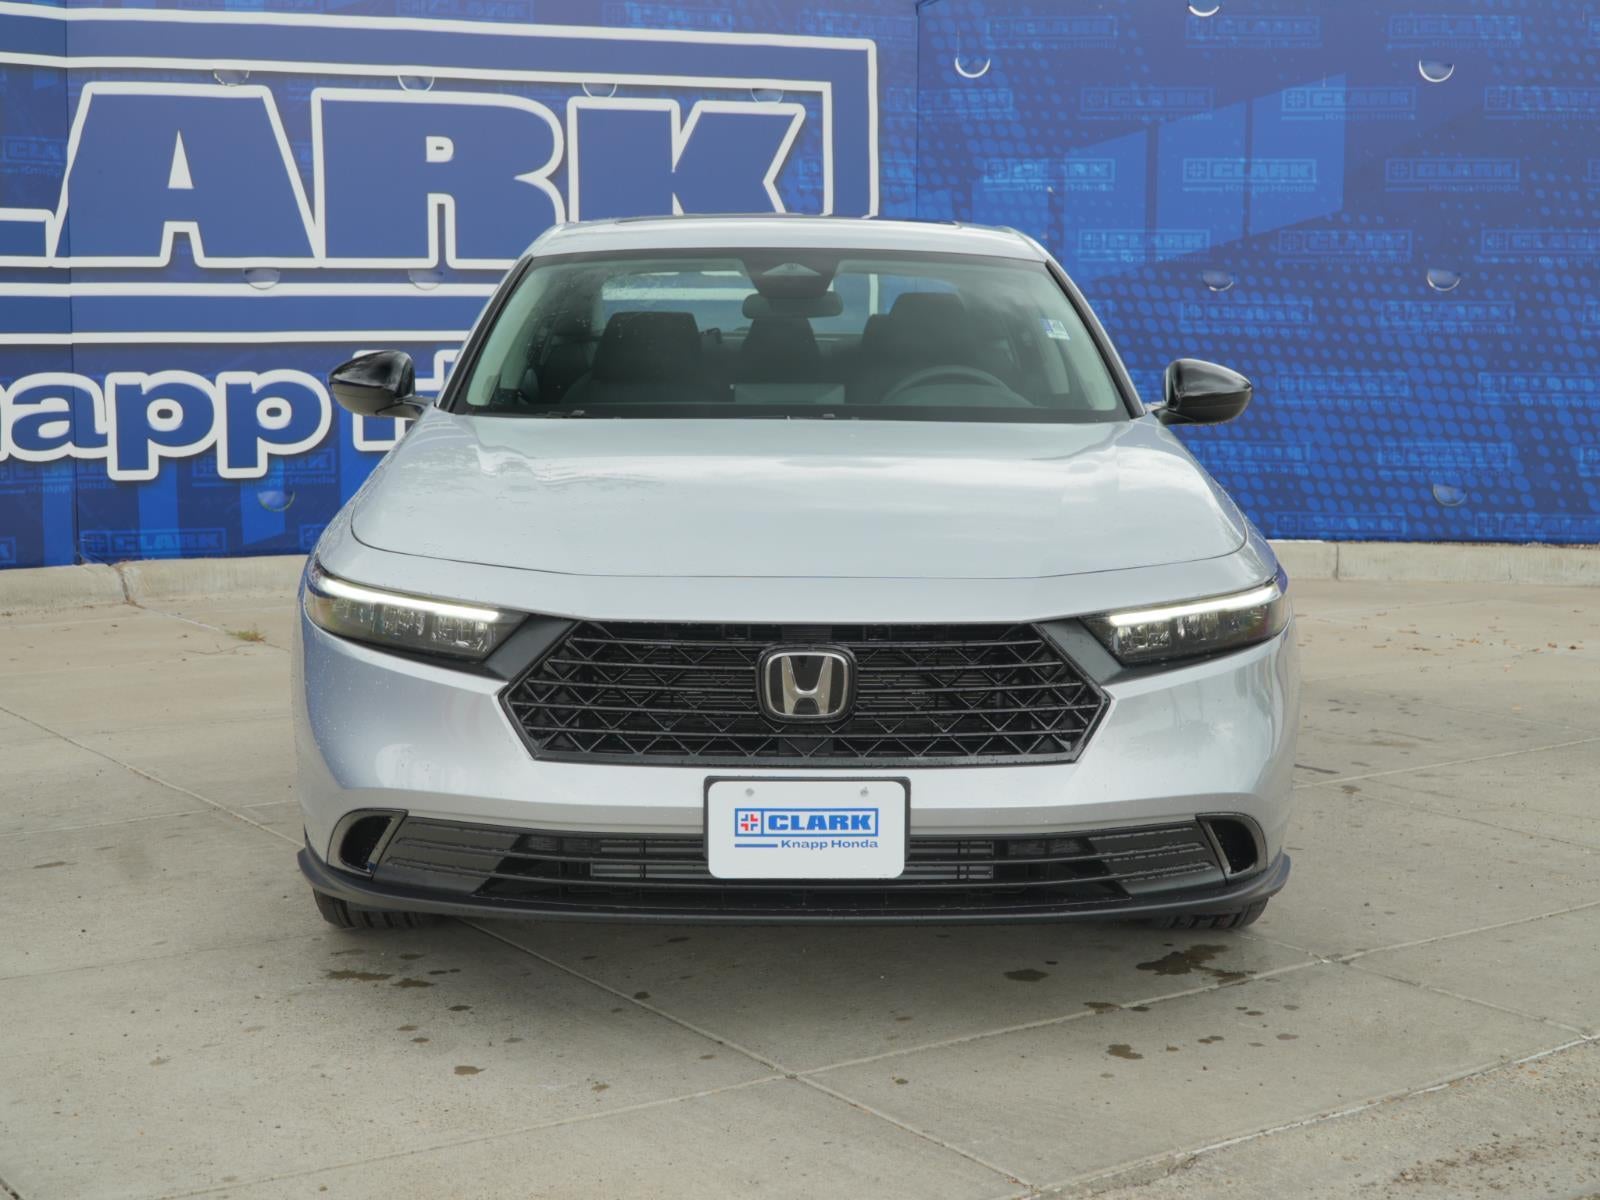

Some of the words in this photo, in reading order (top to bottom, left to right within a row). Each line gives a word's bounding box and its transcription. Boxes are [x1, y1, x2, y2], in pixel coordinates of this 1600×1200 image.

[1312, 92, 1408, 106] CLARK
[0, 80, 806, 270] ARK
[1212, 163, 1310, 178] CLARK
[1416, 164, 1513, 178] CLARK
[1108, 234, 1204, 249] CLARK
[1308, 234, 1406, 249] CLARK
[0, 368, 332, 481] app
[110, 534, 220, 551] CLARK
[767, 814, 872, 831] CLARK
[781, 840, 828, 850] Knapp
[831, 839, 879, 849] Honda
